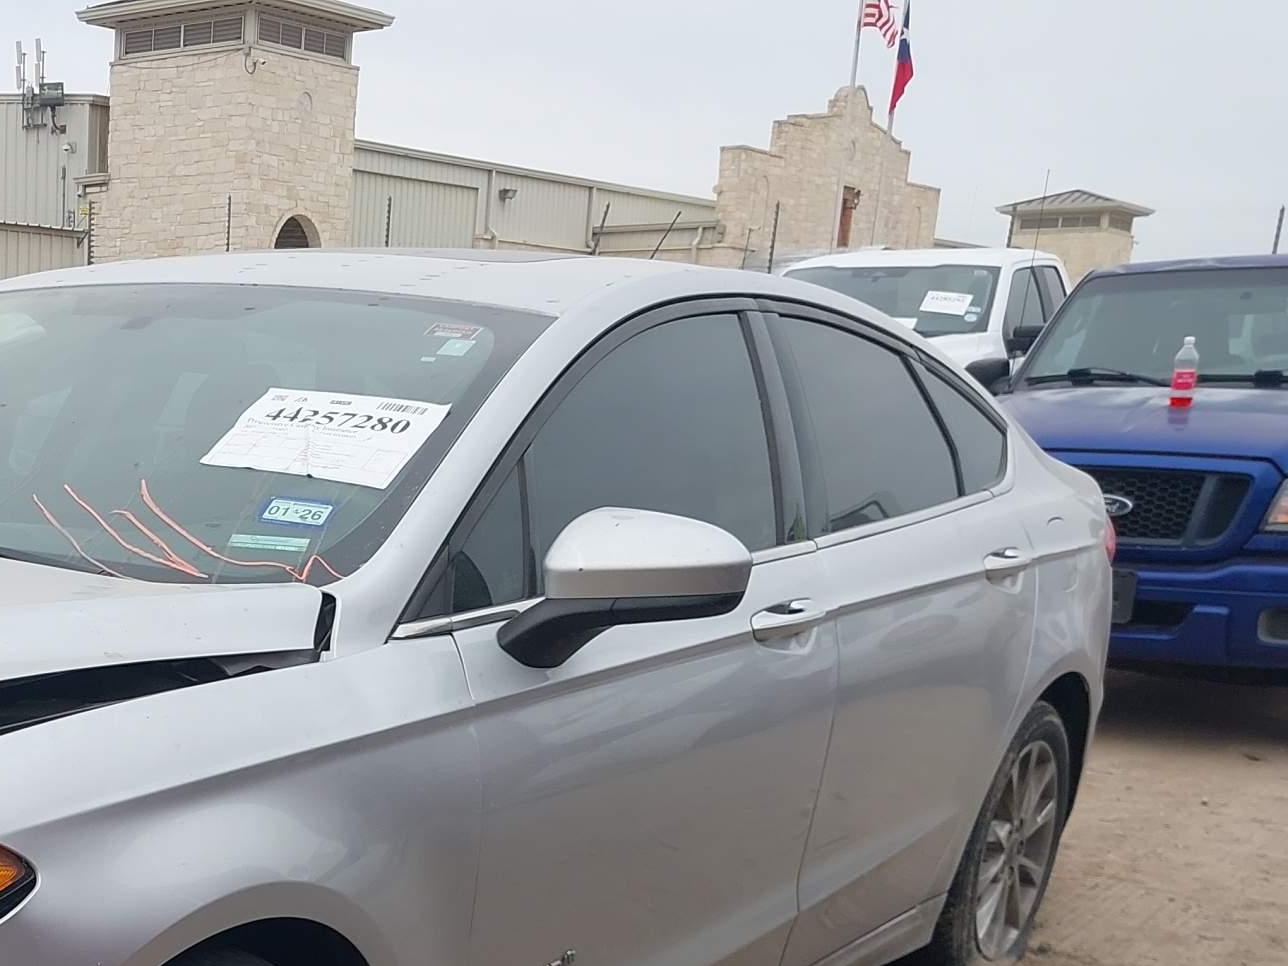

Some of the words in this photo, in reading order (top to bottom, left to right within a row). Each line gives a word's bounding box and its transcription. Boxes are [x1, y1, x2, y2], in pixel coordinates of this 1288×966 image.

[265, 406, 411, 434] 44257280
[267, 505, 290, 516] 01
[298, 508, 324, 521] 26
